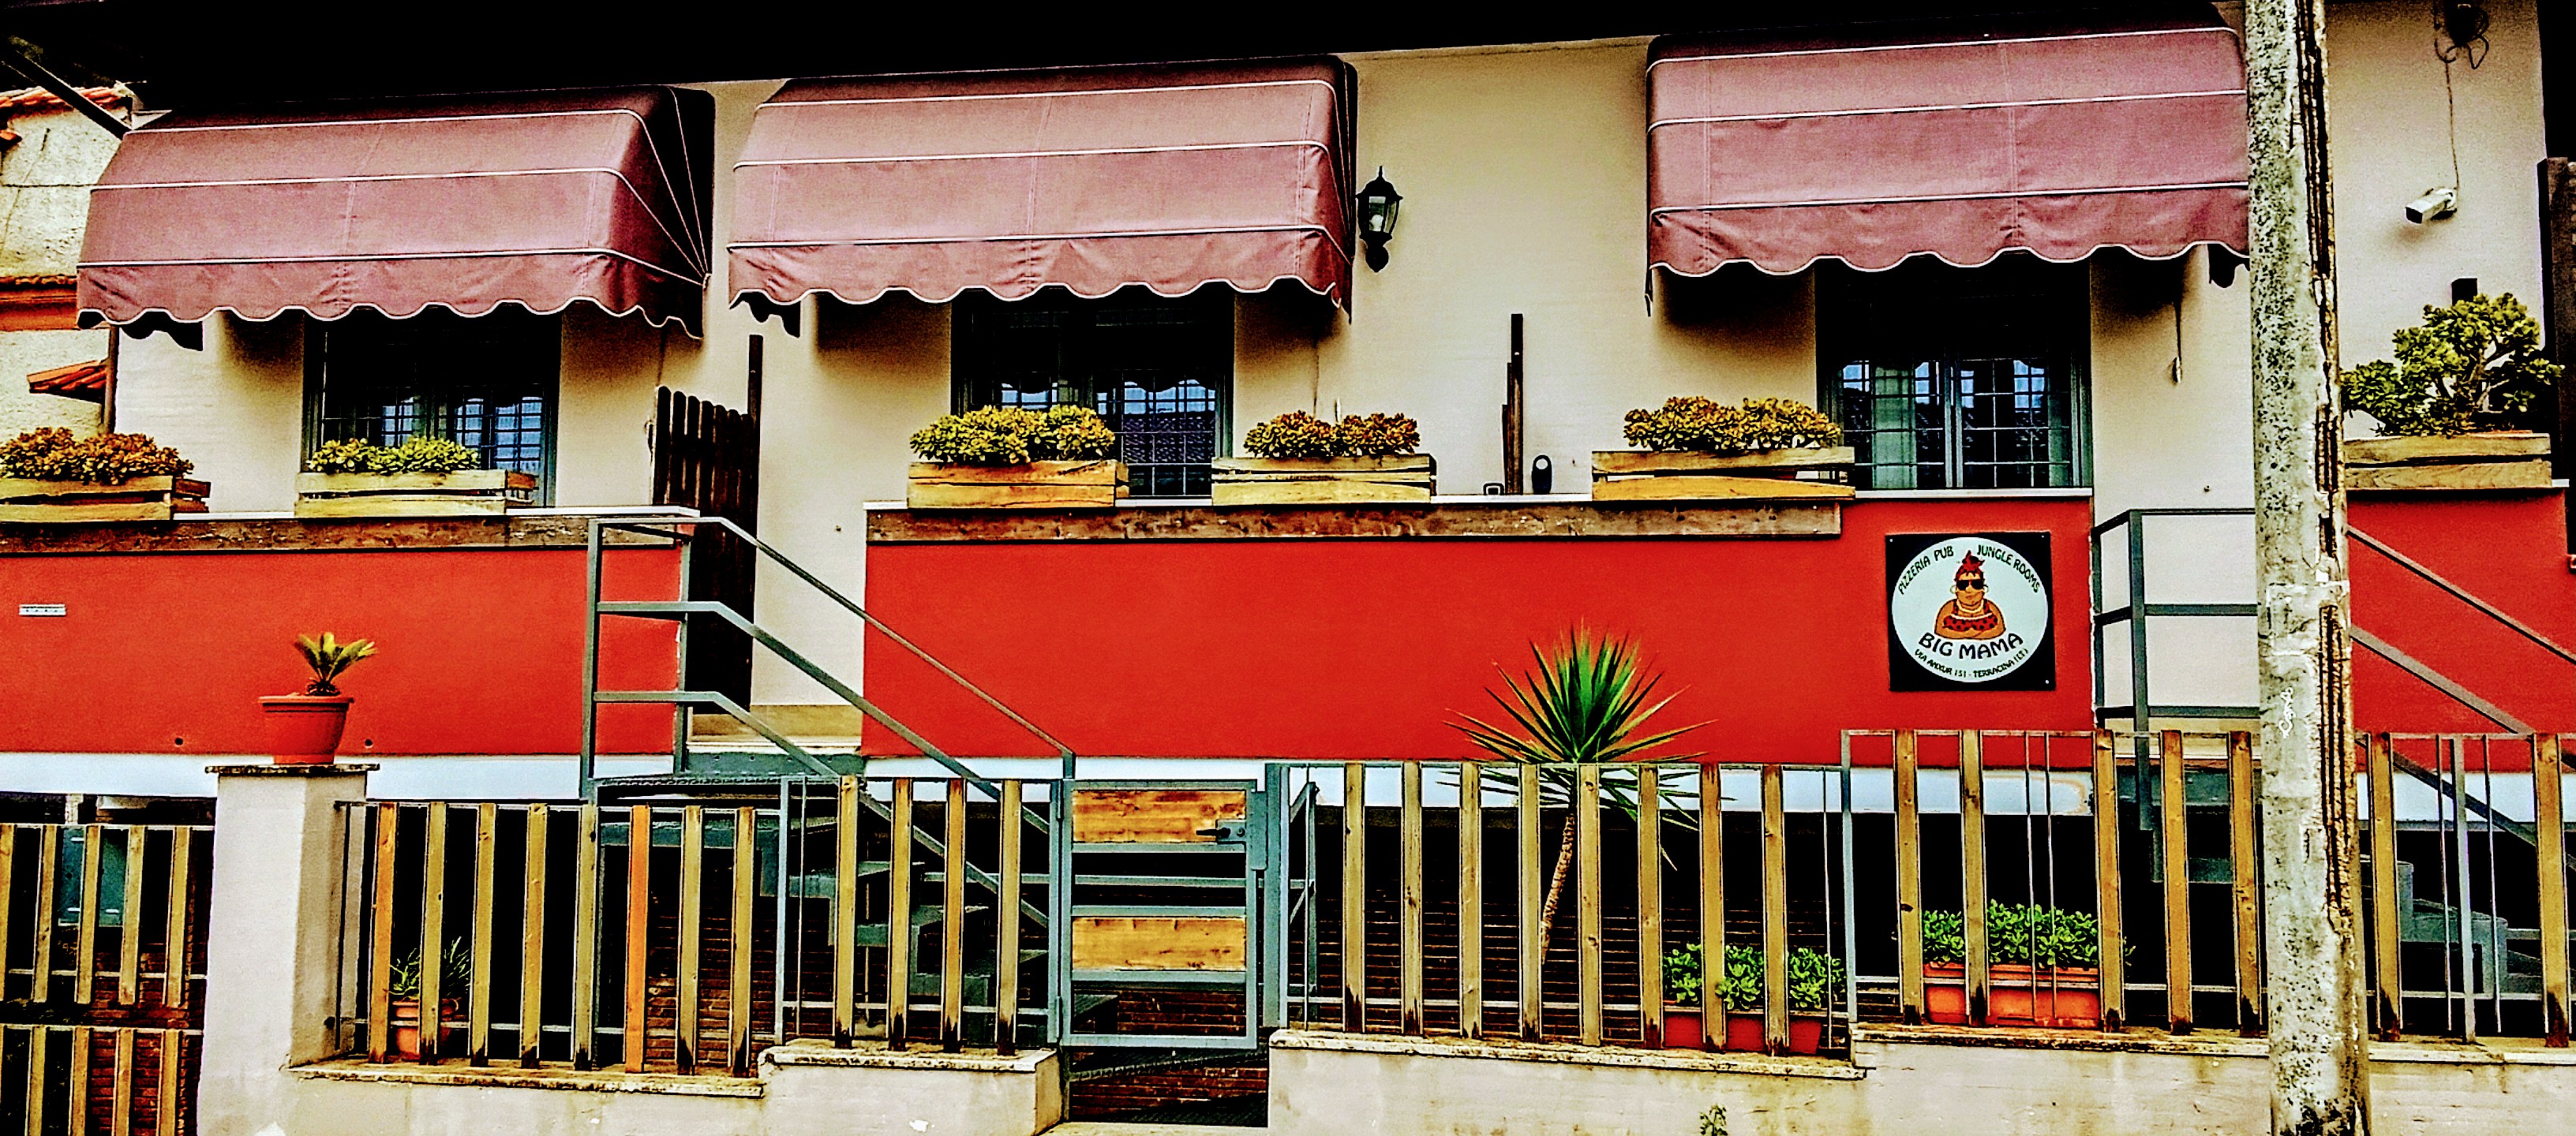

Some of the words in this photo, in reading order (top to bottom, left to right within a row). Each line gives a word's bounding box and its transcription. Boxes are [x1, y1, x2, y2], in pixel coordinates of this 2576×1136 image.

[1898, 556, 1930, 594] PIZZERIA
[1934, 546, 1954, 561] PUB
[1977, 544, 2013, 566] JUNGLE
[2013, 559, 2040, 593] ROOMS
[1915, 648, 1927, 662] VIA
[1954, 669, 1967, 678] 151
[1972, 660, 2015, 678] TERRACINA
[1919, 632, 1953, 656] BIG
[1959, 633, 2024, 659] MAMA
